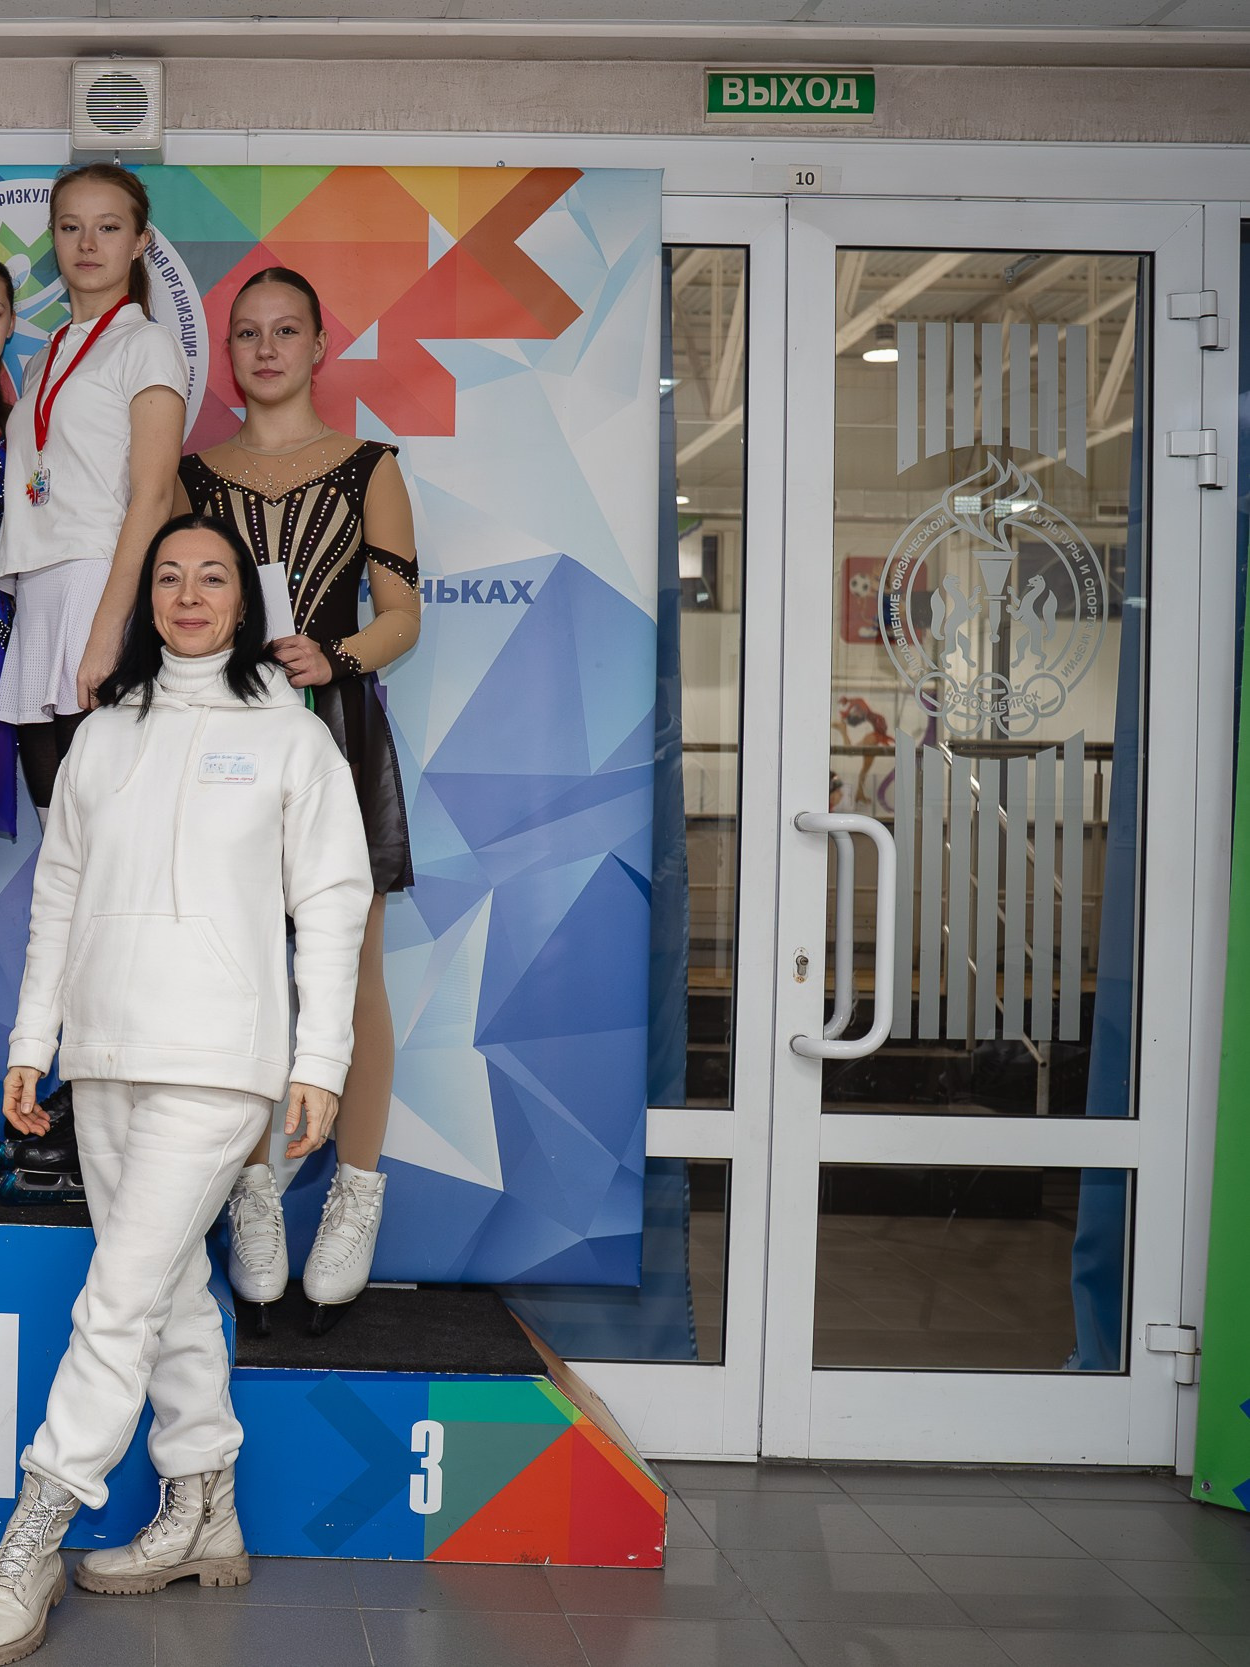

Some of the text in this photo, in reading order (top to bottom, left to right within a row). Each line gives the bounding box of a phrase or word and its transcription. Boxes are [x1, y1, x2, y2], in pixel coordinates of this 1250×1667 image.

[722, 77, 859, 109] ВЫХОД
[795, 172, 815, 185] 10
[161, 267, 197, 357] ОРГАНИЗАЦИЯ
[359, 579, 535, 604] КНЬКАХ
[890, 511, 1097, 678] УПРАВЛЕНИЕ ФИЗИЧЕСКОЙ КУЛЬТУРЫ И СПОРТА МЭРИИ
[944, 690, 1042, 711] НОВОСИБИРСК
[410, 1420, 443, 1514] 3
